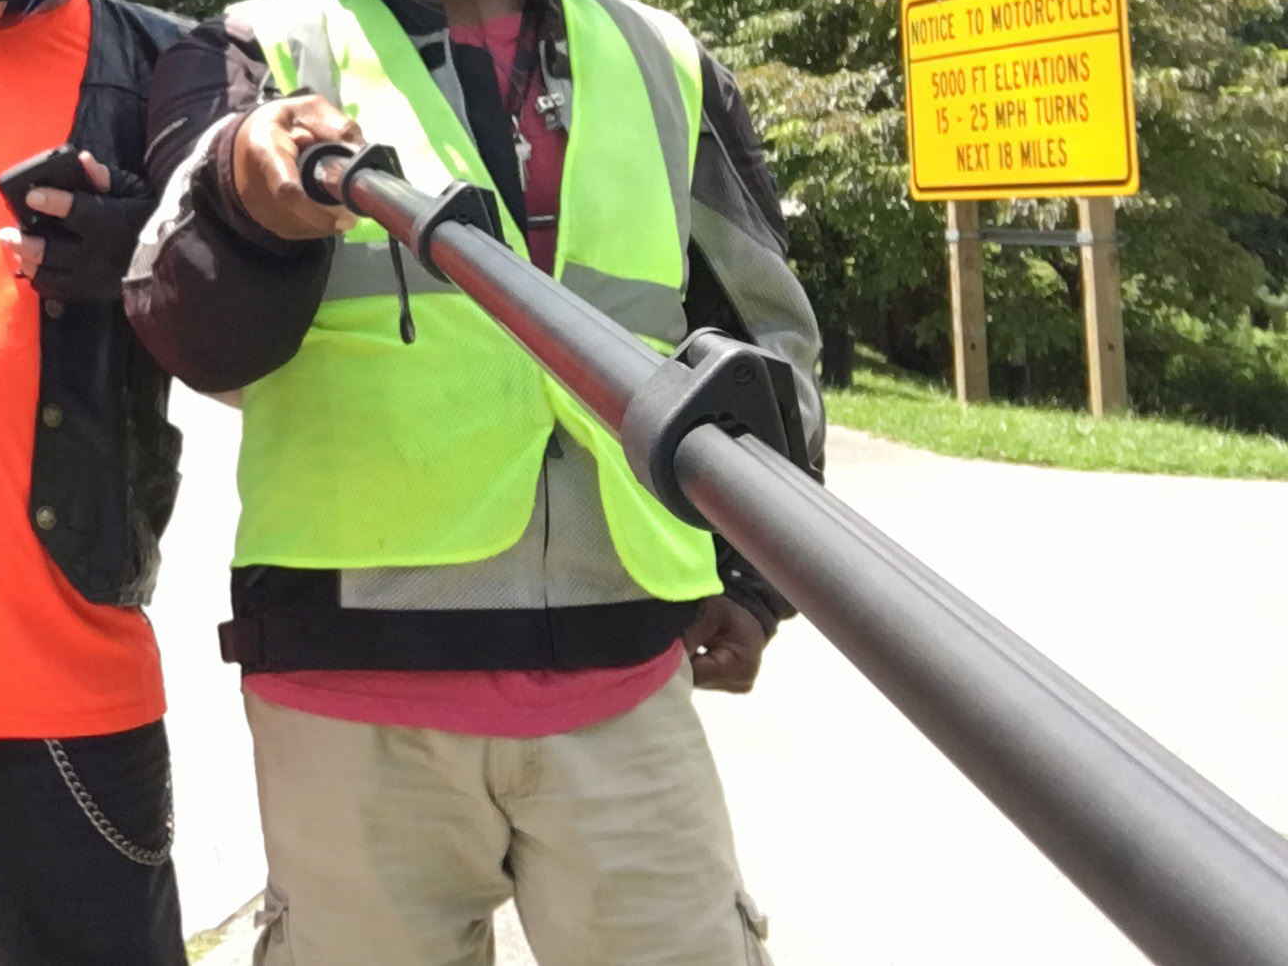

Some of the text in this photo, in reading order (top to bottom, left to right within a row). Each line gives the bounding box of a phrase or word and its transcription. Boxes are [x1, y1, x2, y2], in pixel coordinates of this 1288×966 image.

[911, 13, 956, 46] NOTICE
[967, 9, 984, 36] TO
[932, 52, 1090, 99] 5000 FT ELEVATIONS
[936, 107, 949, 134] 15
[970, 103, 988, 132] 25
[995, 99, 1026, 130] MPH
[1034, 93, 1089, 126] TURNS
[956, 138, 1068, 172] NEXT 18 MILES
